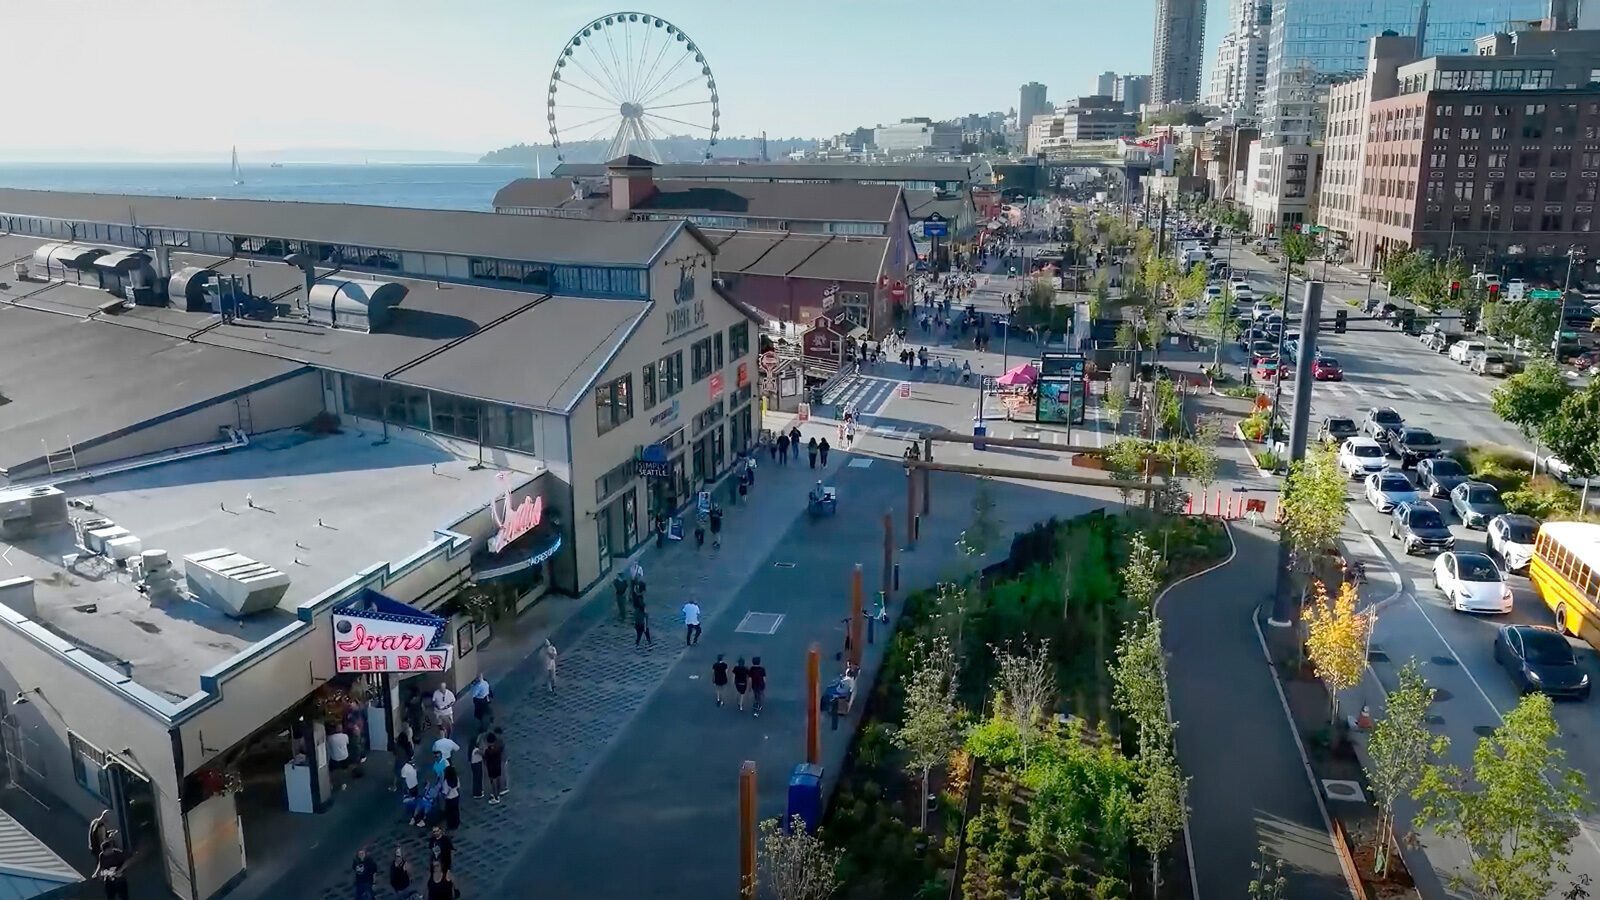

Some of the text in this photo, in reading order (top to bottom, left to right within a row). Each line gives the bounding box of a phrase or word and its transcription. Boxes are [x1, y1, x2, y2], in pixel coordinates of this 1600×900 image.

[639, 462, 667, 470] SIMPLY
[639, 469, 669, 477] SEATTLE
[338, 655, 444, 671] FISH BAR
